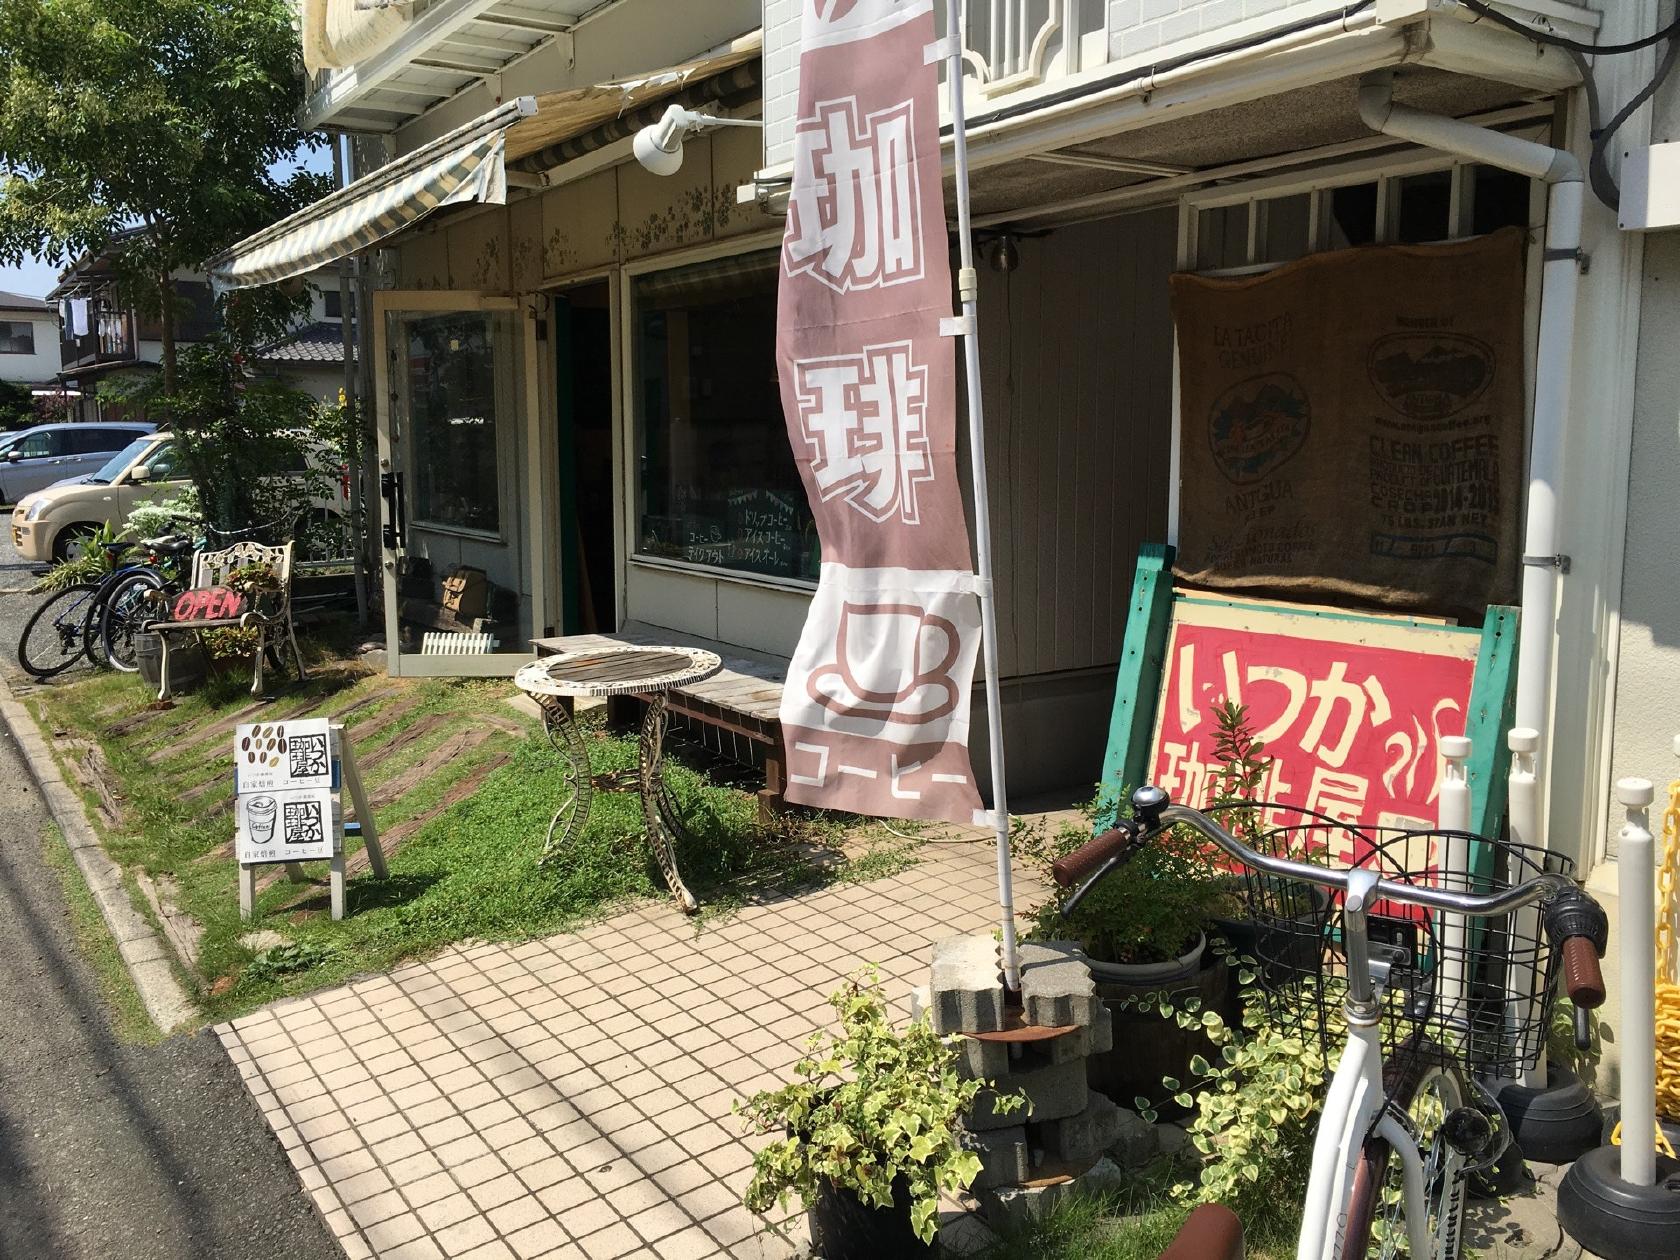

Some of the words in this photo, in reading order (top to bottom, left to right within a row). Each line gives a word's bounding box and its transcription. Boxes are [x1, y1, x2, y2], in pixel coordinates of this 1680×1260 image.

[783, 95, 934, 525] 珈琲
[1369, 435, 1424, 464] CLEAN
[1428, 434, 1499, 463] COFFEE
[174, 587, 241, 620] OPEN
[1179, 644, 1392, 767] いつか
[790, 741, 968, 800] コーヒー
